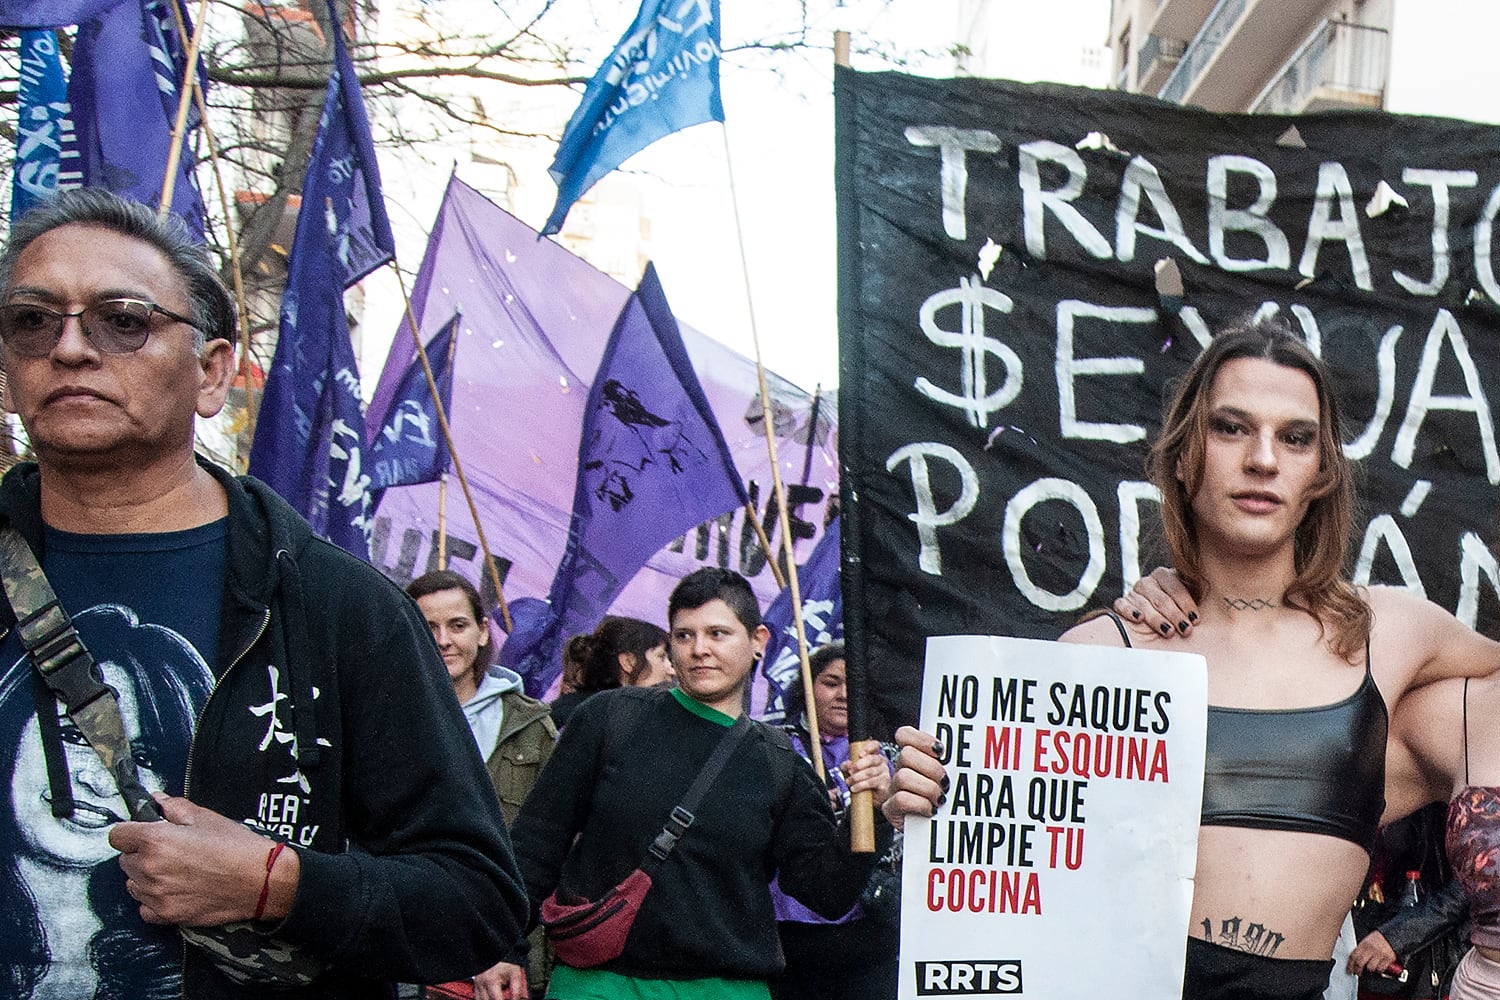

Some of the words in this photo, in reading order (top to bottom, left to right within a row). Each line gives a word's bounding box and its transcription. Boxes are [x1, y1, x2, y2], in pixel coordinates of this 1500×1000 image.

[938, 675, 979, 719] NO
[991, 677, 1037, 723] ME
[1047, 682, 1171, 734] SAQUES
[936, 723, 973, 767] DE
[984, 726, 1022, 770] MI
[1034, 729, 1169, 783] ESQUINA
[951, 773, 1015, 818] ARA
[1028, 777, 1088, 823] QUE
[929, 819, 1035, 867] LIMPIE
[1046, 826, 1084, 870] TU
[927, 868, 1042, 915] COCINA
[924, 963, 1020, 991] RRTS
